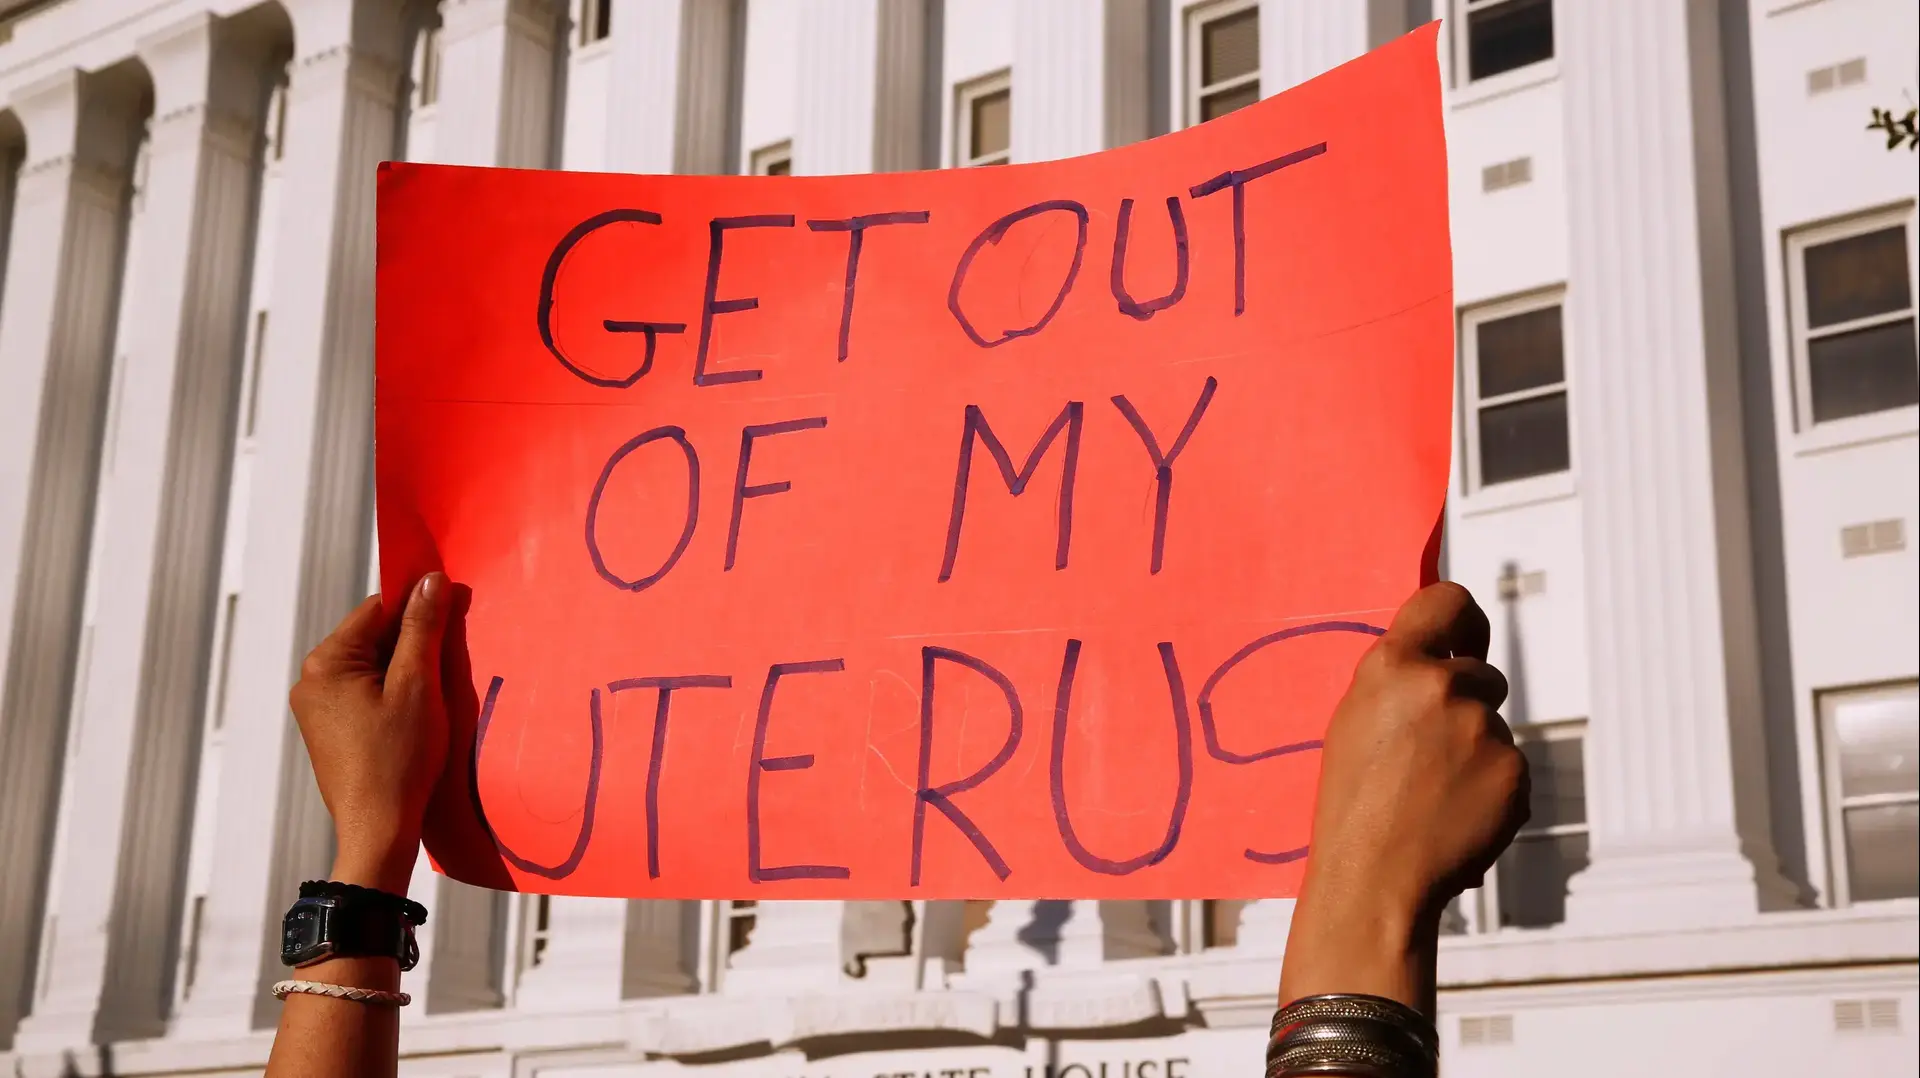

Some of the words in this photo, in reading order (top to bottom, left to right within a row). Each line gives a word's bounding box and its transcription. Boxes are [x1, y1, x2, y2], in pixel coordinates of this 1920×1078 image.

[536, 209, 931, 389] GET
[948, 142, 1328, 349] OUT
[585, 416, 829, 592] OF
[938, 376, 1218, 583] MY
[468, 620, 1388, 886] UTERUS
